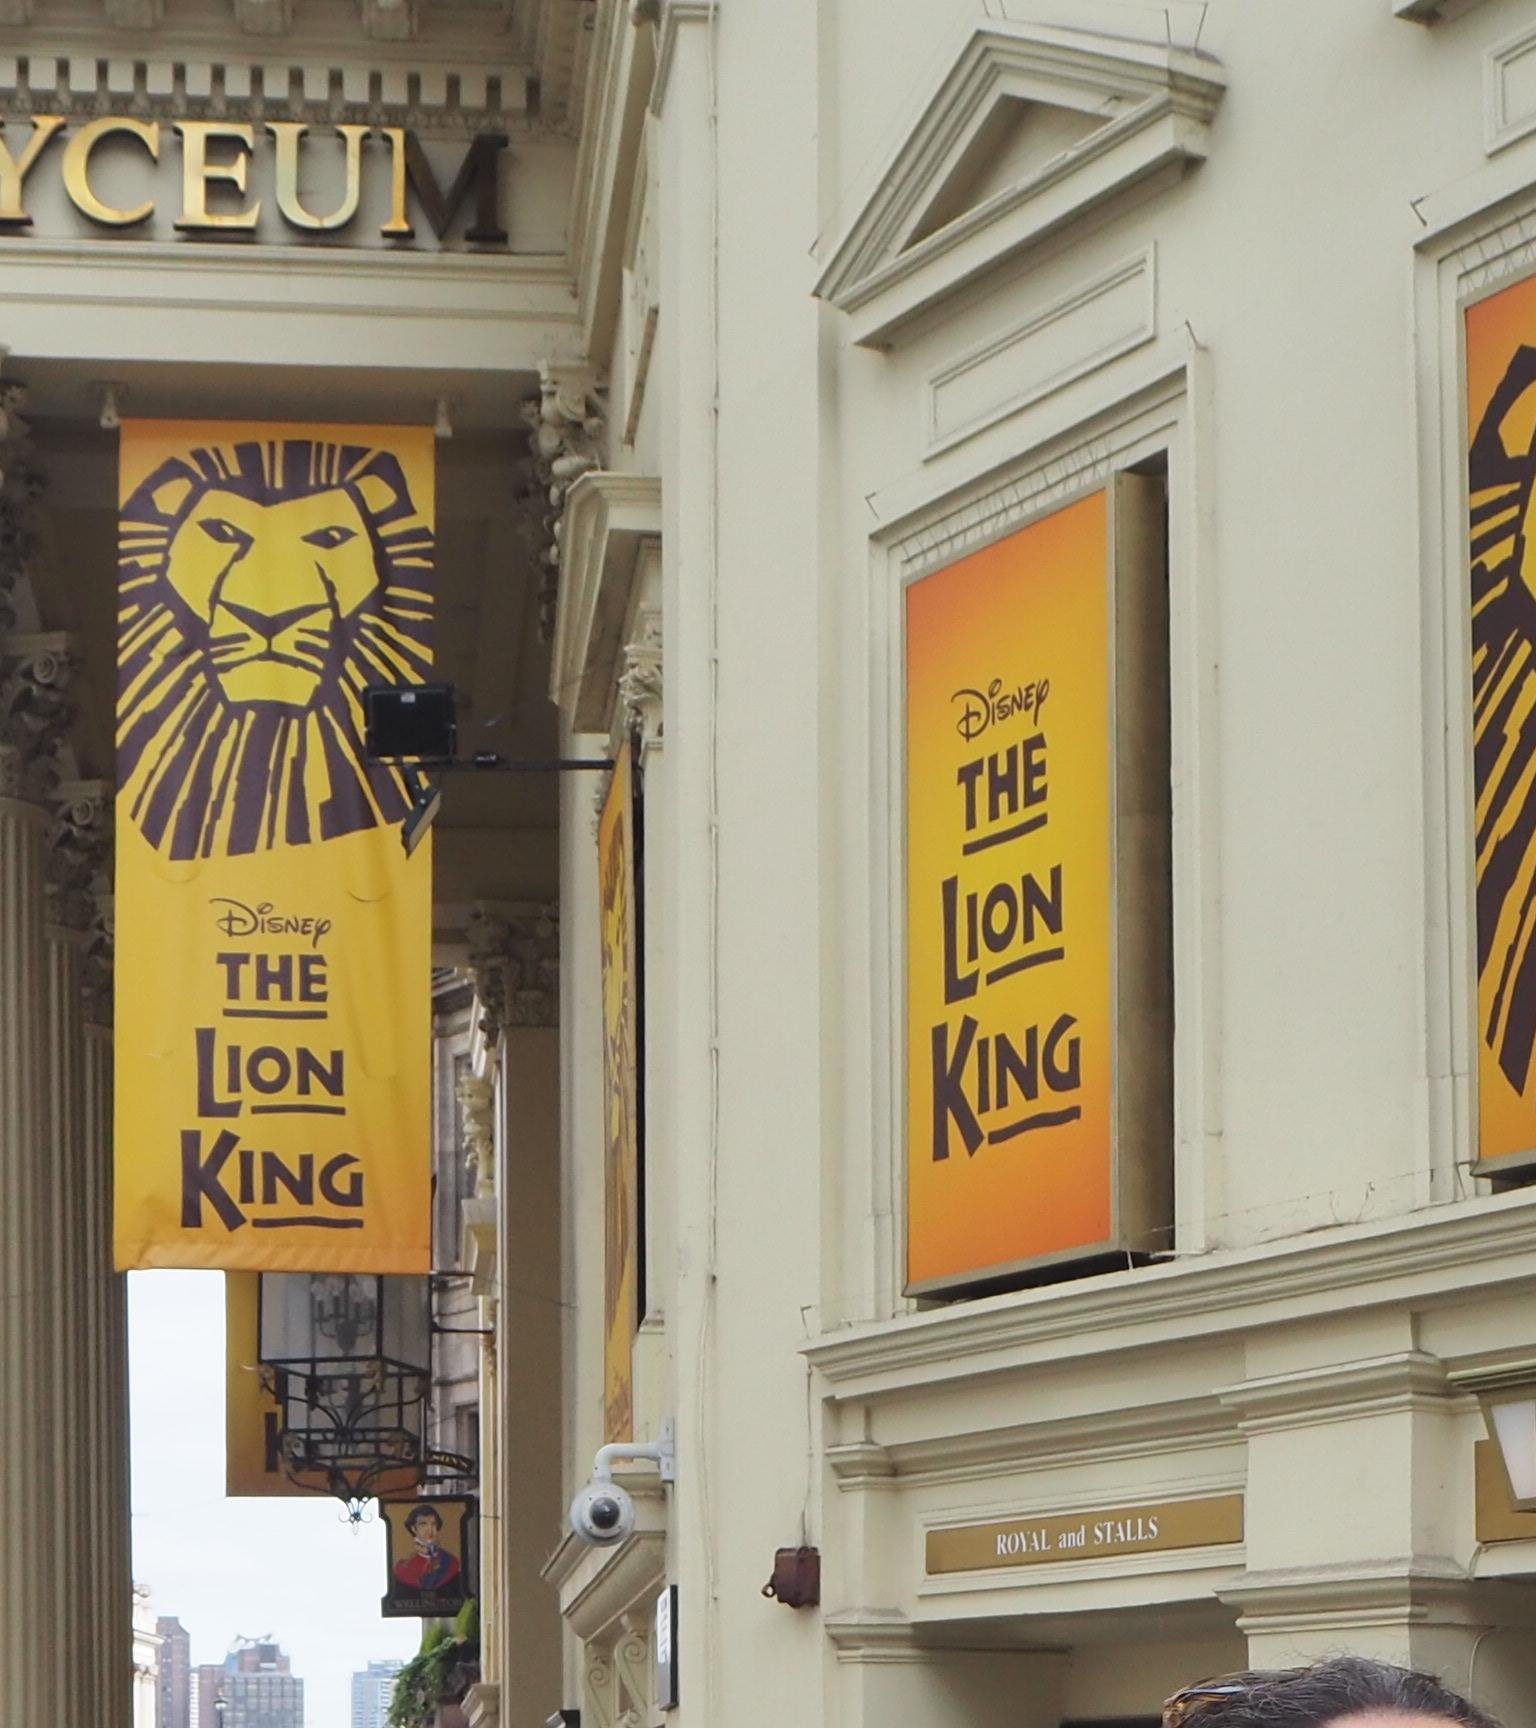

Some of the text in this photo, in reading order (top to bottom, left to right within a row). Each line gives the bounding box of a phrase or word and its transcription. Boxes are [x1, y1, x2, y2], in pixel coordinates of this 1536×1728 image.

[950, 678, 1050, 742] Disney
[957, 732, 1049, 832] THE
[208, 897, 332, 948] Disney
[942, 863, 1063, 1006] LION
[216, 952, 329, 1002] THE
[195, 1026, 345, 1118] LION
[931, 1013, 1082, 1163] KING
[180, 1129, 364, 1232] KING
[996, 1516, 1160, 1556] ROYAL and STALLS
